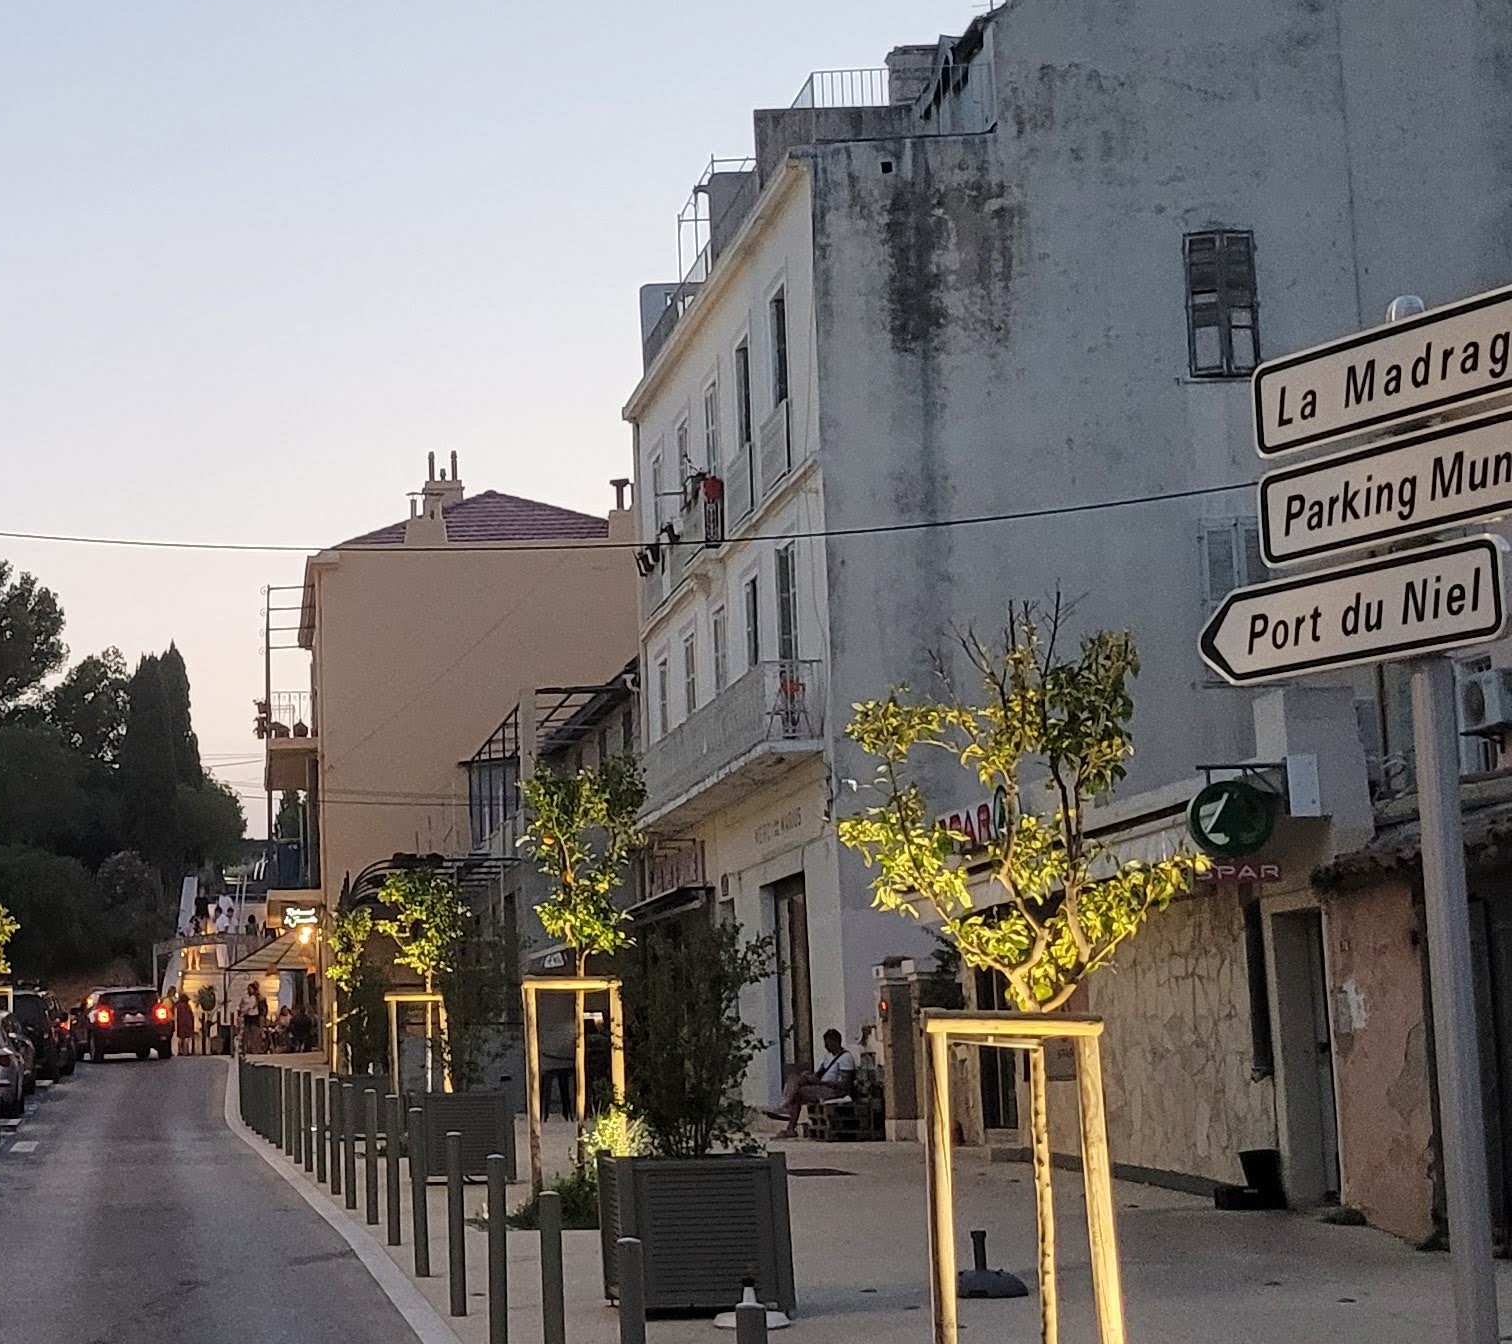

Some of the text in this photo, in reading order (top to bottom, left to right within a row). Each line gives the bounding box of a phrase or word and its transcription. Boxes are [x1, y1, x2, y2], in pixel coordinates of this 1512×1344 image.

[1277, 331, 1511, 428] La Madrag
[1284, 451, 1512, 537] Parking Mun
[1247, 567, 1481, 656] Port du Niel
